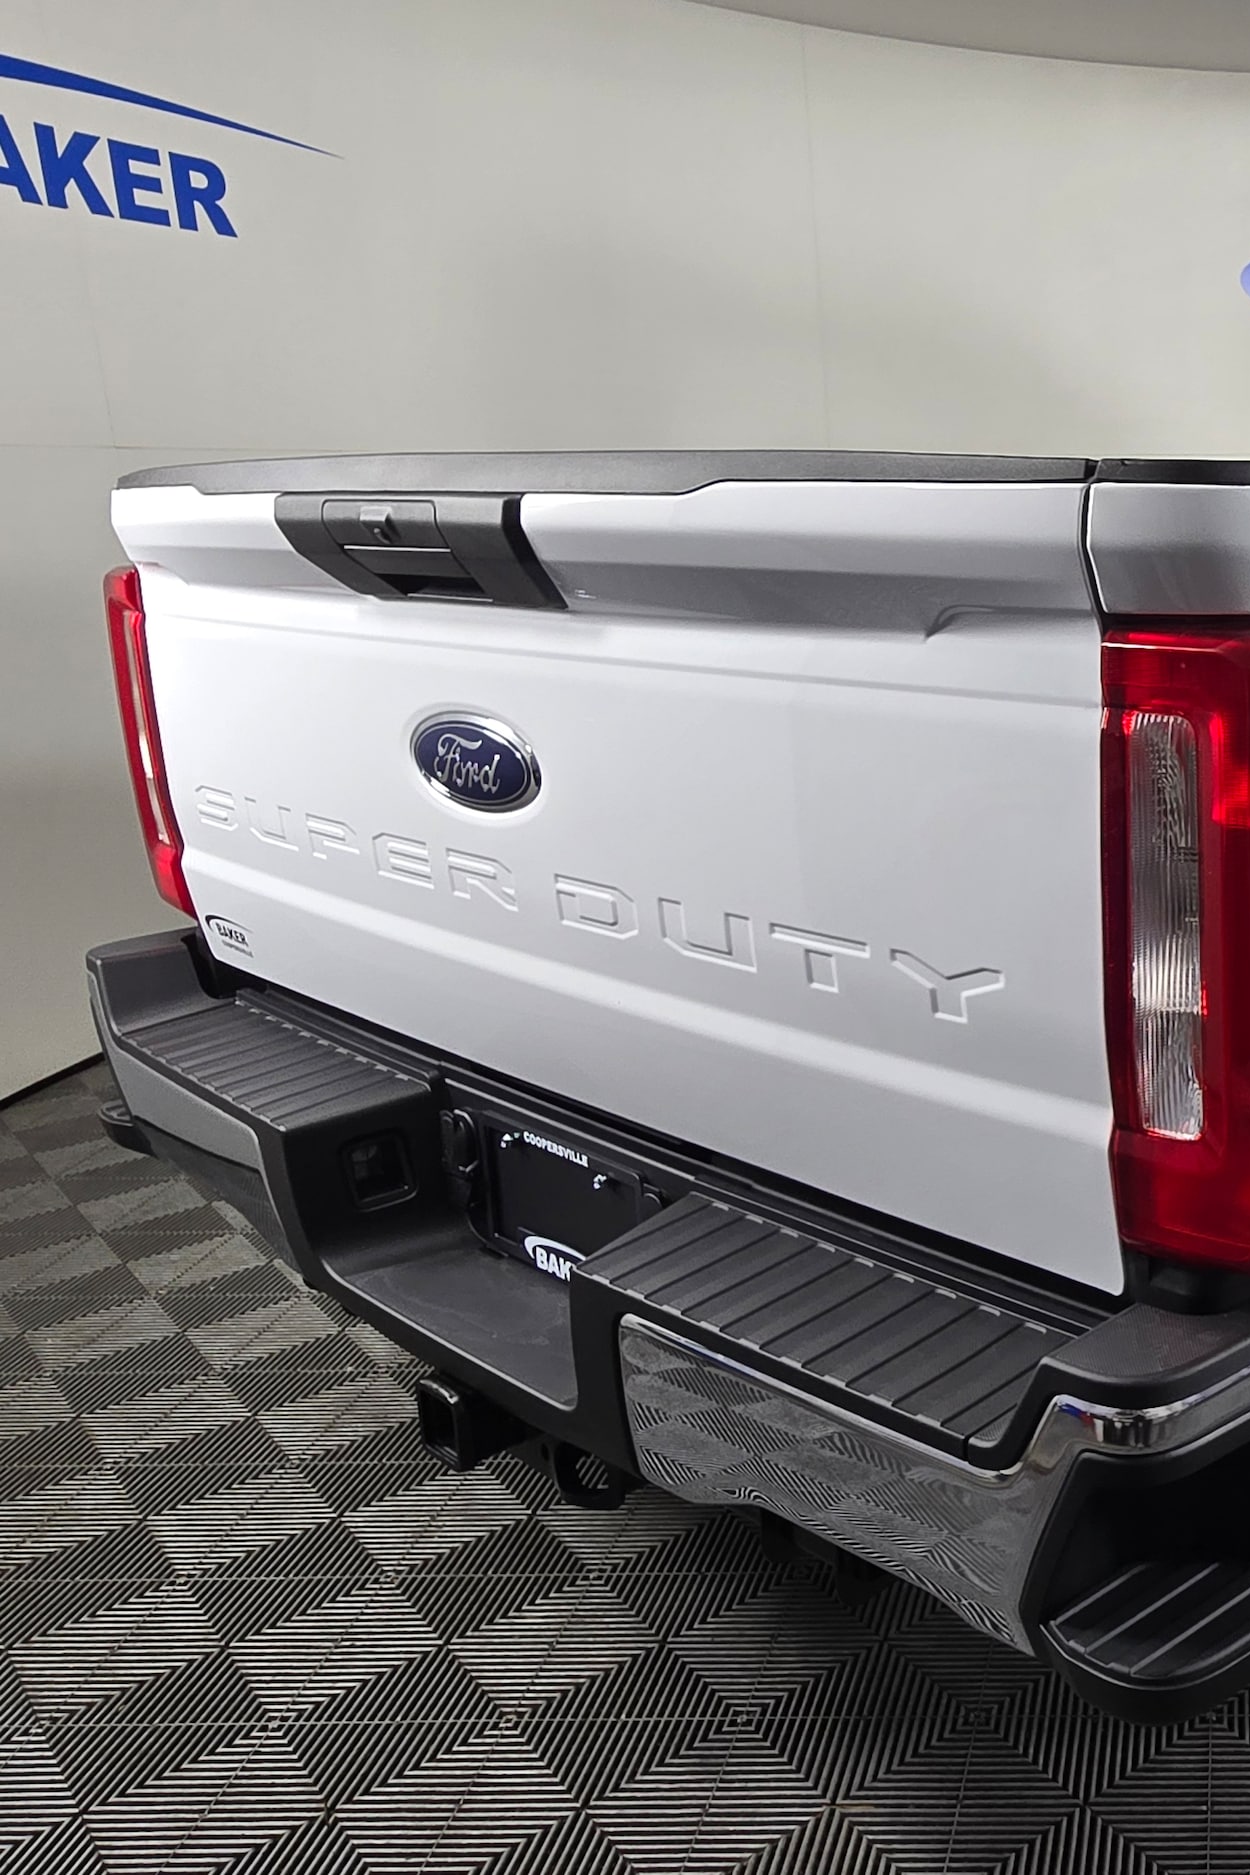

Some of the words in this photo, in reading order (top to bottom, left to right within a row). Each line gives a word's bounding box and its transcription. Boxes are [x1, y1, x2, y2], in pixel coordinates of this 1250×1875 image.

[0, 114, 238, 237] AKER
[433, 733, 501, 794] Ford
[195, 785, 519, 912] SUPER
[554, 873, 1006, 1023] DUTY
[215, 921, 249, 947] BAKER
[523, 1131, 588, 1168] COOPERSVILLE
[535, 1246, 571, 1282] BAK
